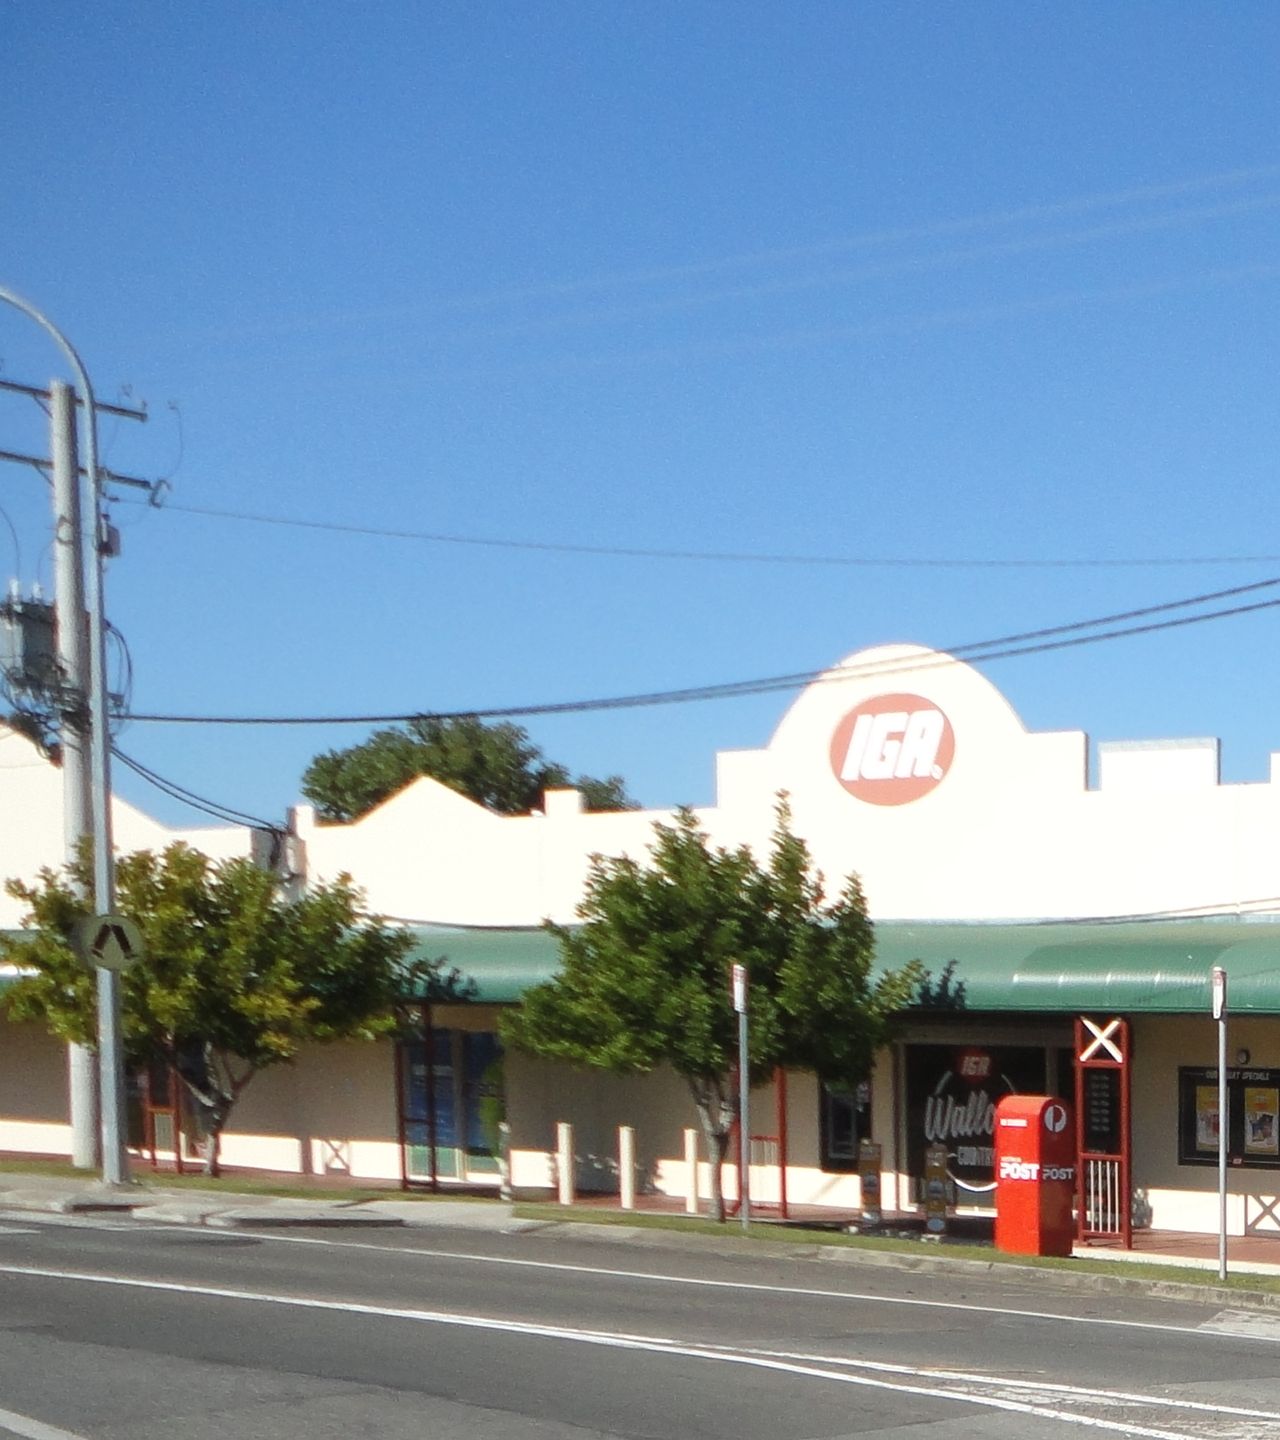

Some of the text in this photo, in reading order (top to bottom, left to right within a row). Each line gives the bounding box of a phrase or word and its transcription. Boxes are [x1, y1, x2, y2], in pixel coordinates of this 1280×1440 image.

[840, 710, 945, 781] IGA
[924, 1089, 997, 1141] Wallo
[1000, 1163, 1040, 1180] POST
[1043, 1168, 1074, 1180] POST
